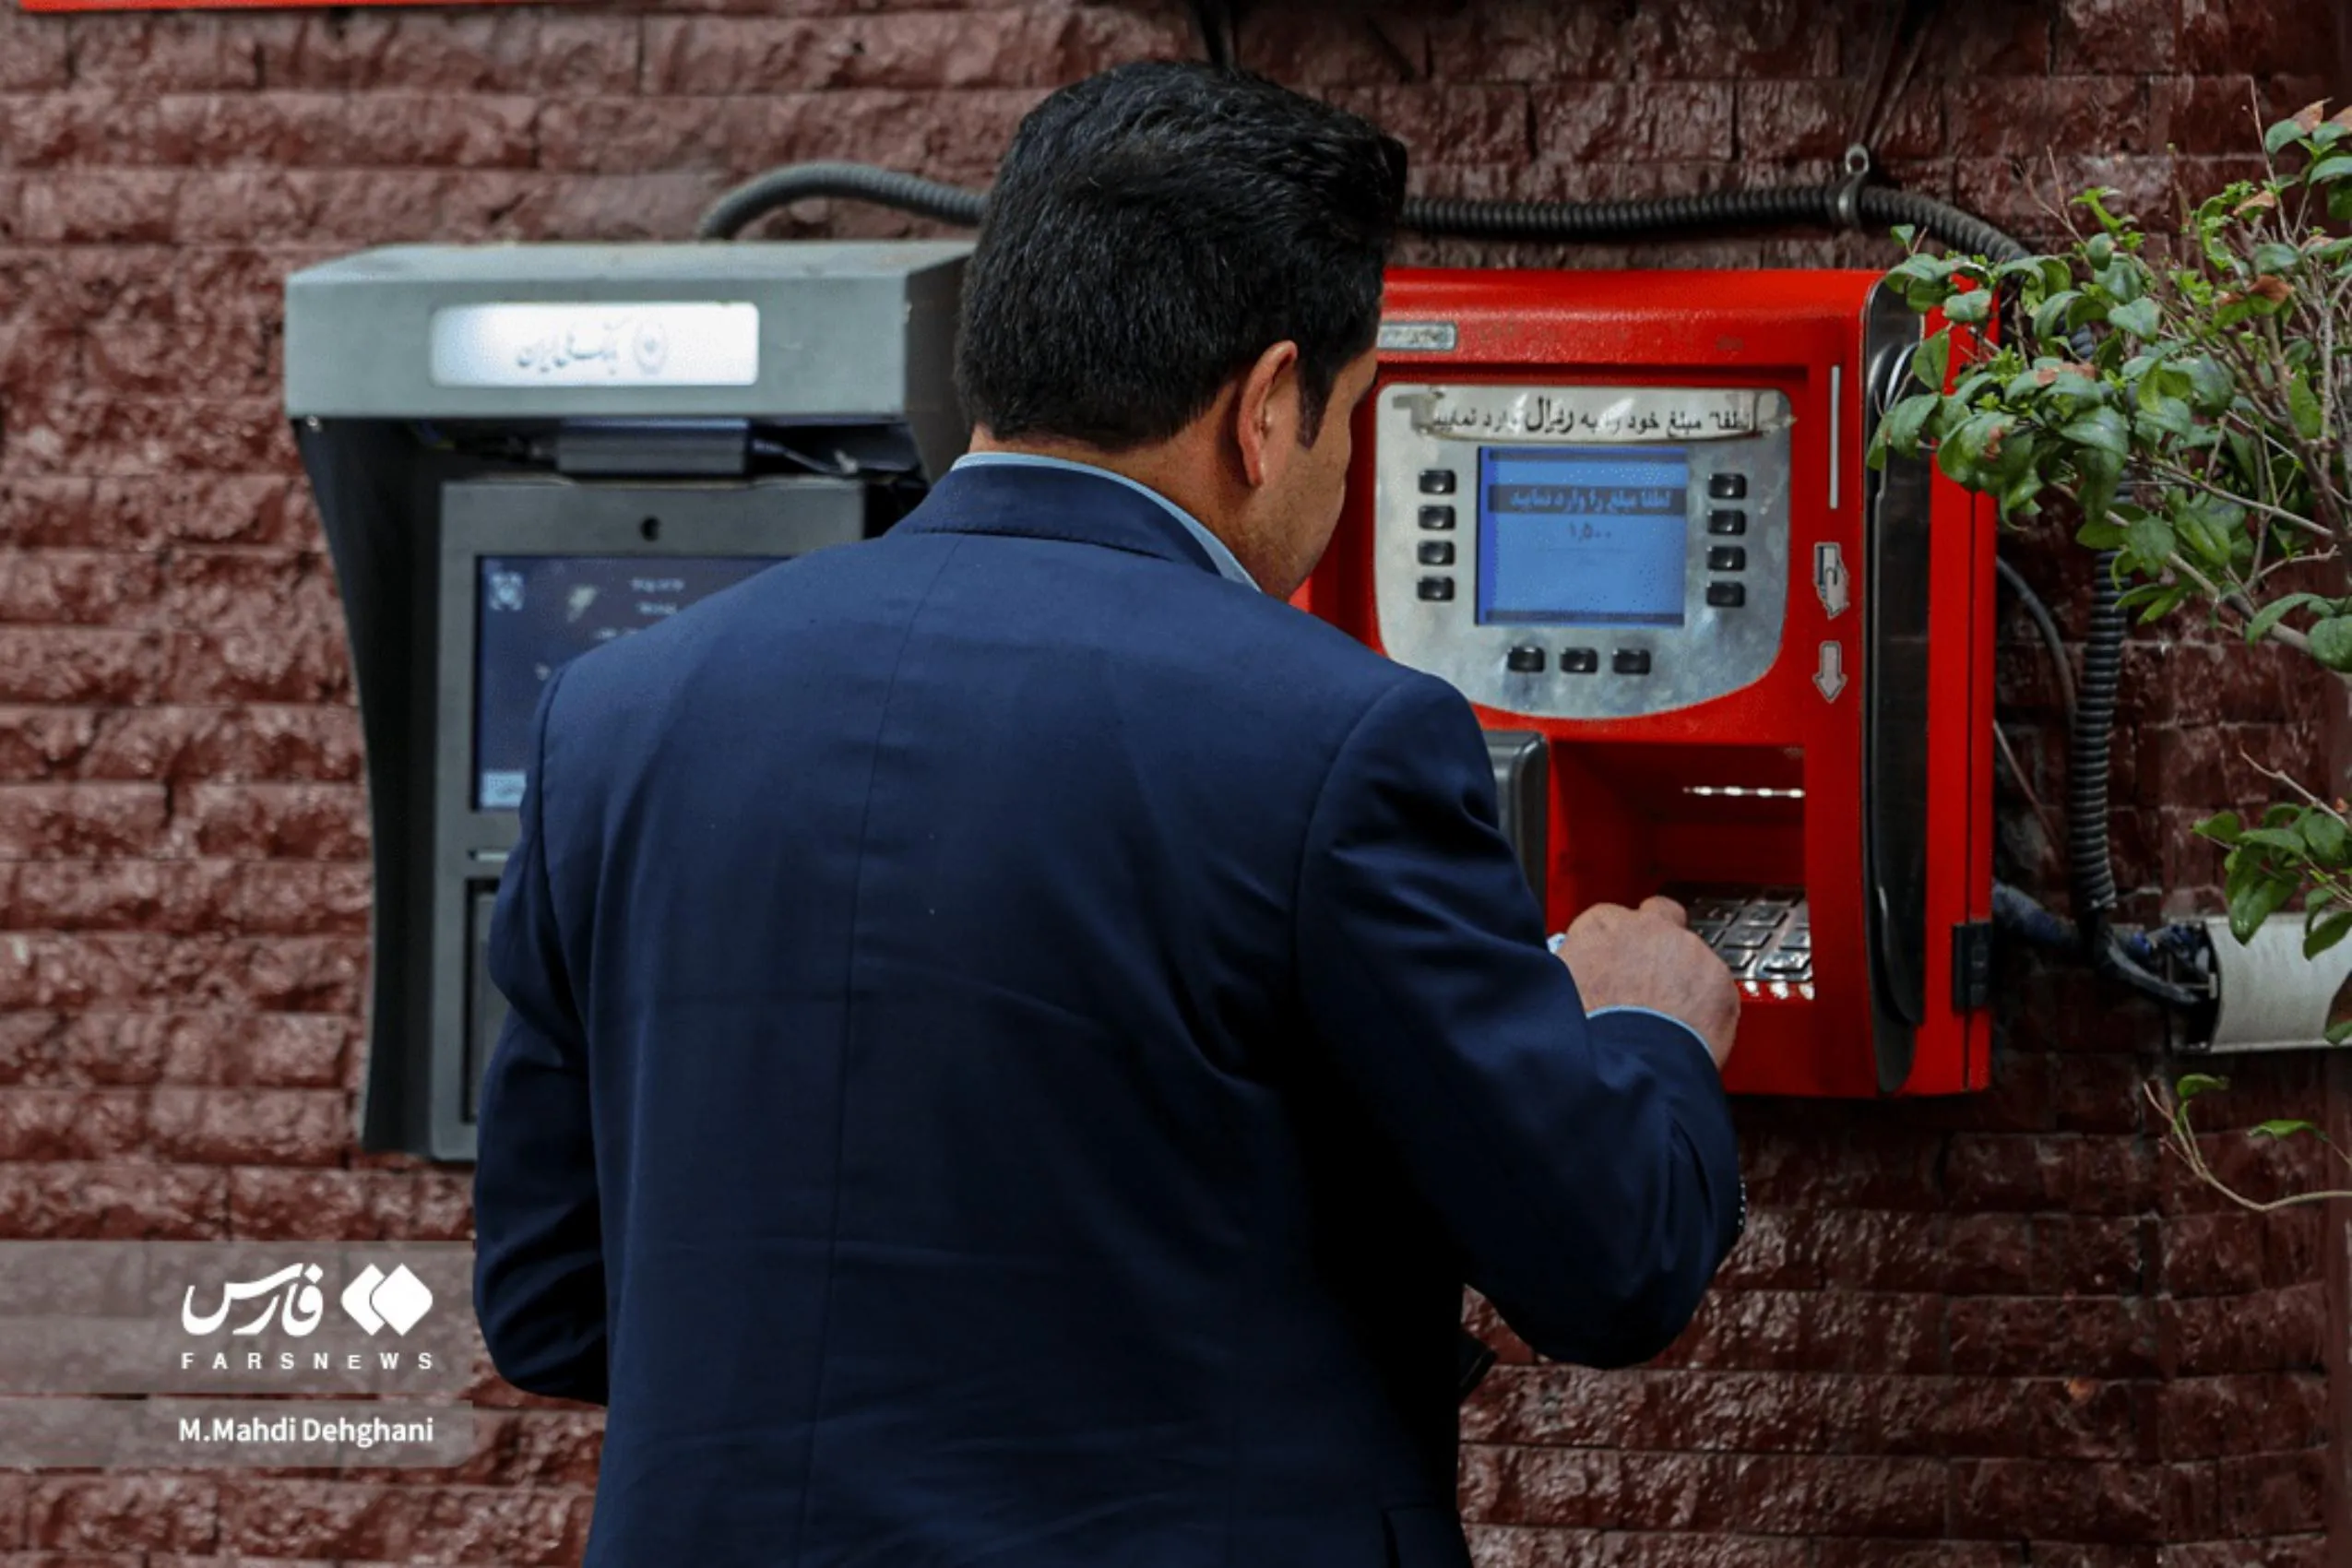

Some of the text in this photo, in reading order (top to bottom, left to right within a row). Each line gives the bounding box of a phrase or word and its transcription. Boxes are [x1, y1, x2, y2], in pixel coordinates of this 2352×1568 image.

[1525, 395, 1574, 434] ریال
[1581, 413, 1599, 434] به
[1628, 411, 1659, 434] خود
[1668, 410, 1702, 437] مبلغ
